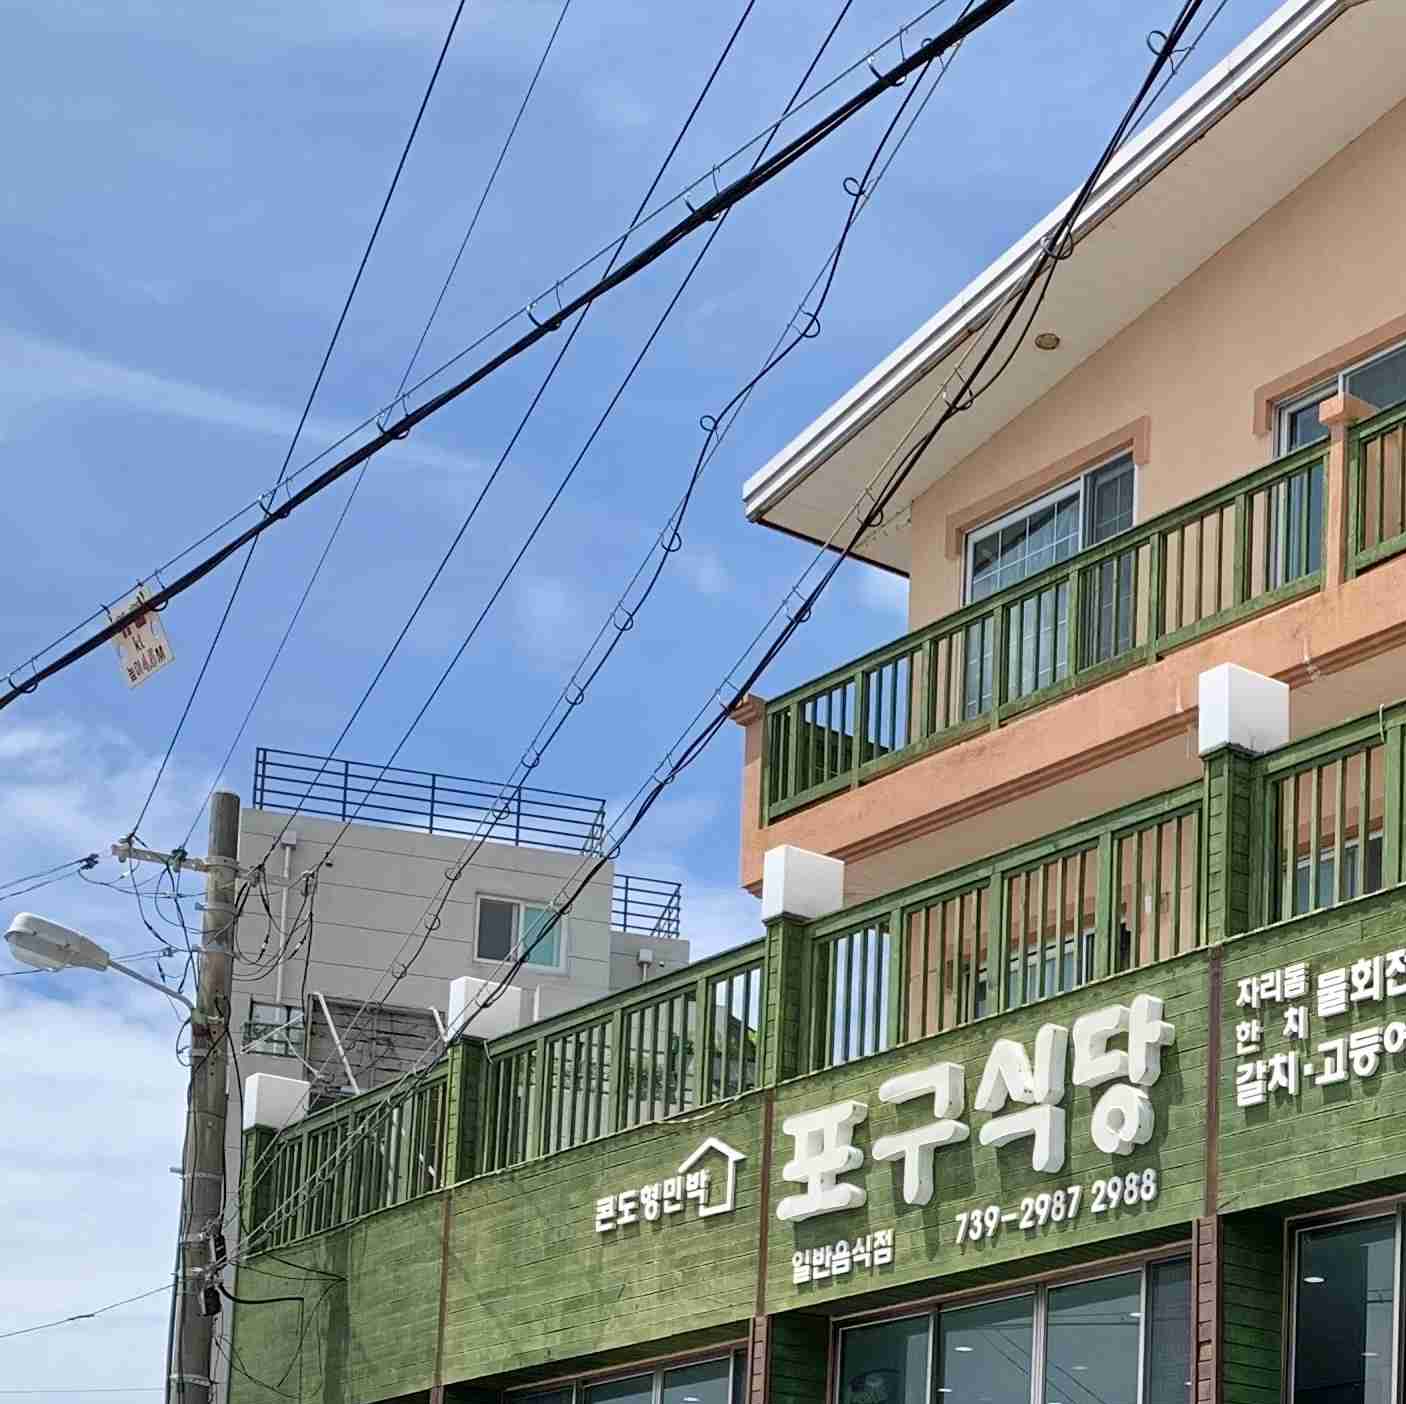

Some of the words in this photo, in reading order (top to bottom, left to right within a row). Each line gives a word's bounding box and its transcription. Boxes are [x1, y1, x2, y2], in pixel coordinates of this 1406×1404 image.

[1236, 961, 1310, 1009] 자리돔
[776, 992, 1176, 1222] 포구식당
[595, 1168, 712, 1233] 콘도형민박
[954, 1184, 1082, 1245] 739-2987
[1090, 1167, 1158, 1213] 2988
[791, 1228, 896, 1285] 일반음식점
